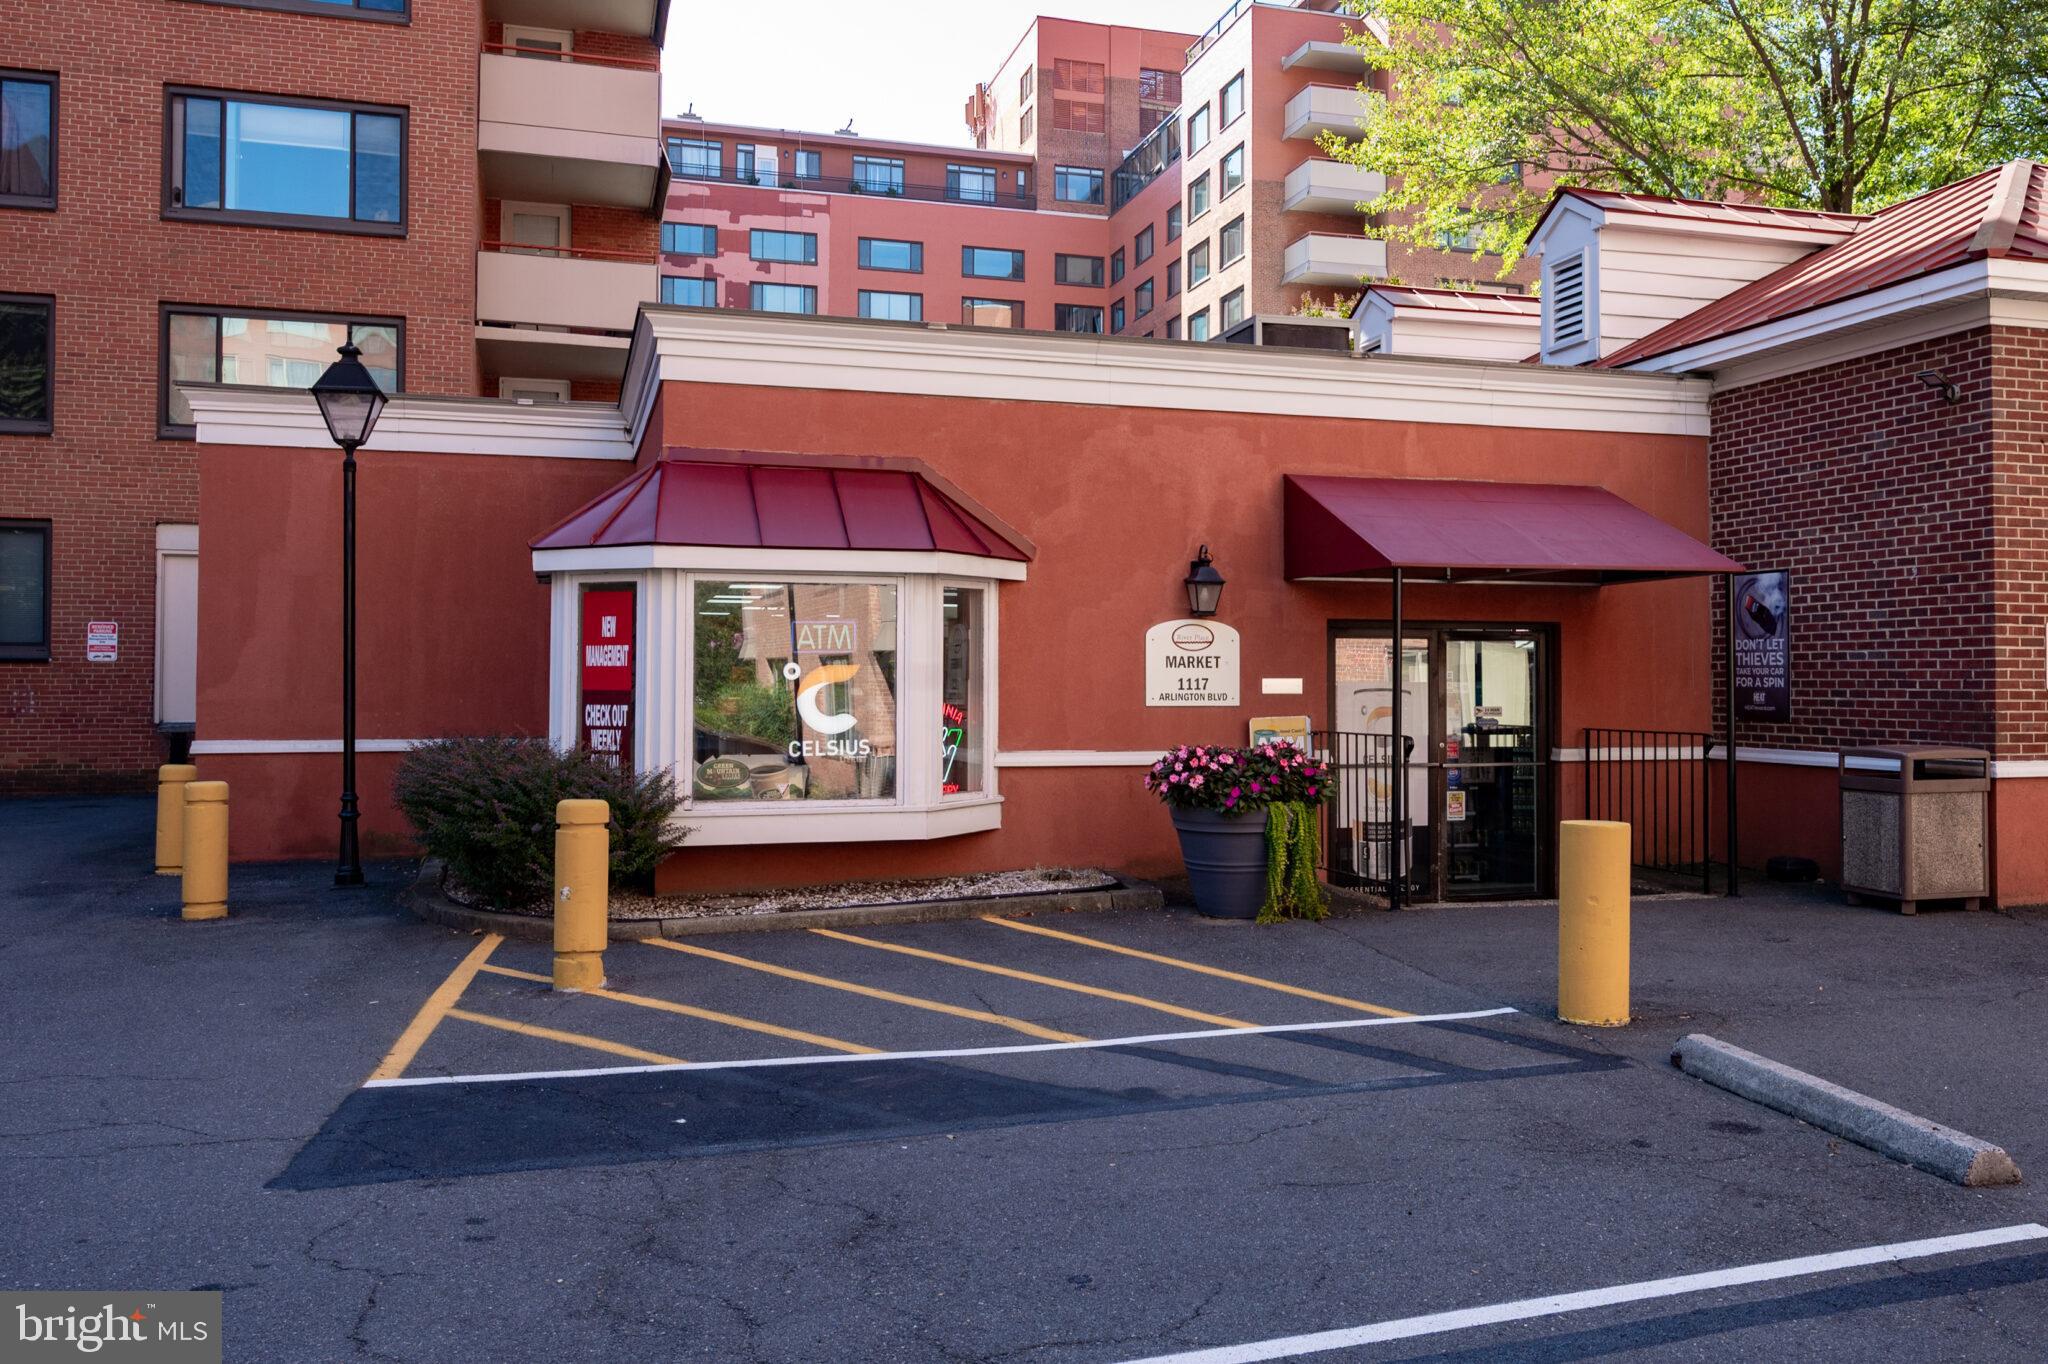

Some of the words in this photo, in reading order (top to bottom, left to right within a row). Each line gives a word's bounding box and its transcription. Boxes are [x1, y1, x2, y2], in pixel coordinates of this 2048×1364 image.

[601, 616, 617, 638] NEW
[797, 624, 852, 650] ATM
[1735, 638, 1765, 650] DON'T
[1766, 638, 1785, 650] LET
[585, 645, 629, 667] MANAGEMENT
[1165, 655, 1221, 669] MARKET
[1736, 652, 1784, 666] THIEVES
[1736, 667, 1752, 675] TAKE
[1752, 667, 1770, 675] YOUR
[1770, 667, 1784, 675] CAR
[1177, 677, 1209, 691] 1117
[1736, 677, 1753, 688] FOR
[1754, 677, 1762, 688] A
[1762, 677, 1785, 688] SPIN
[1158, 692, 1206, 702] ARLINGTON
[1207, 692, 1228, 702] BLVD
[585, 704, 612, 727] CHECK
[612, 704, 628, 726] OUT
[590, 729, 622, 751] WEEKLY
[788, 739, 871, 758] CELSIUS
